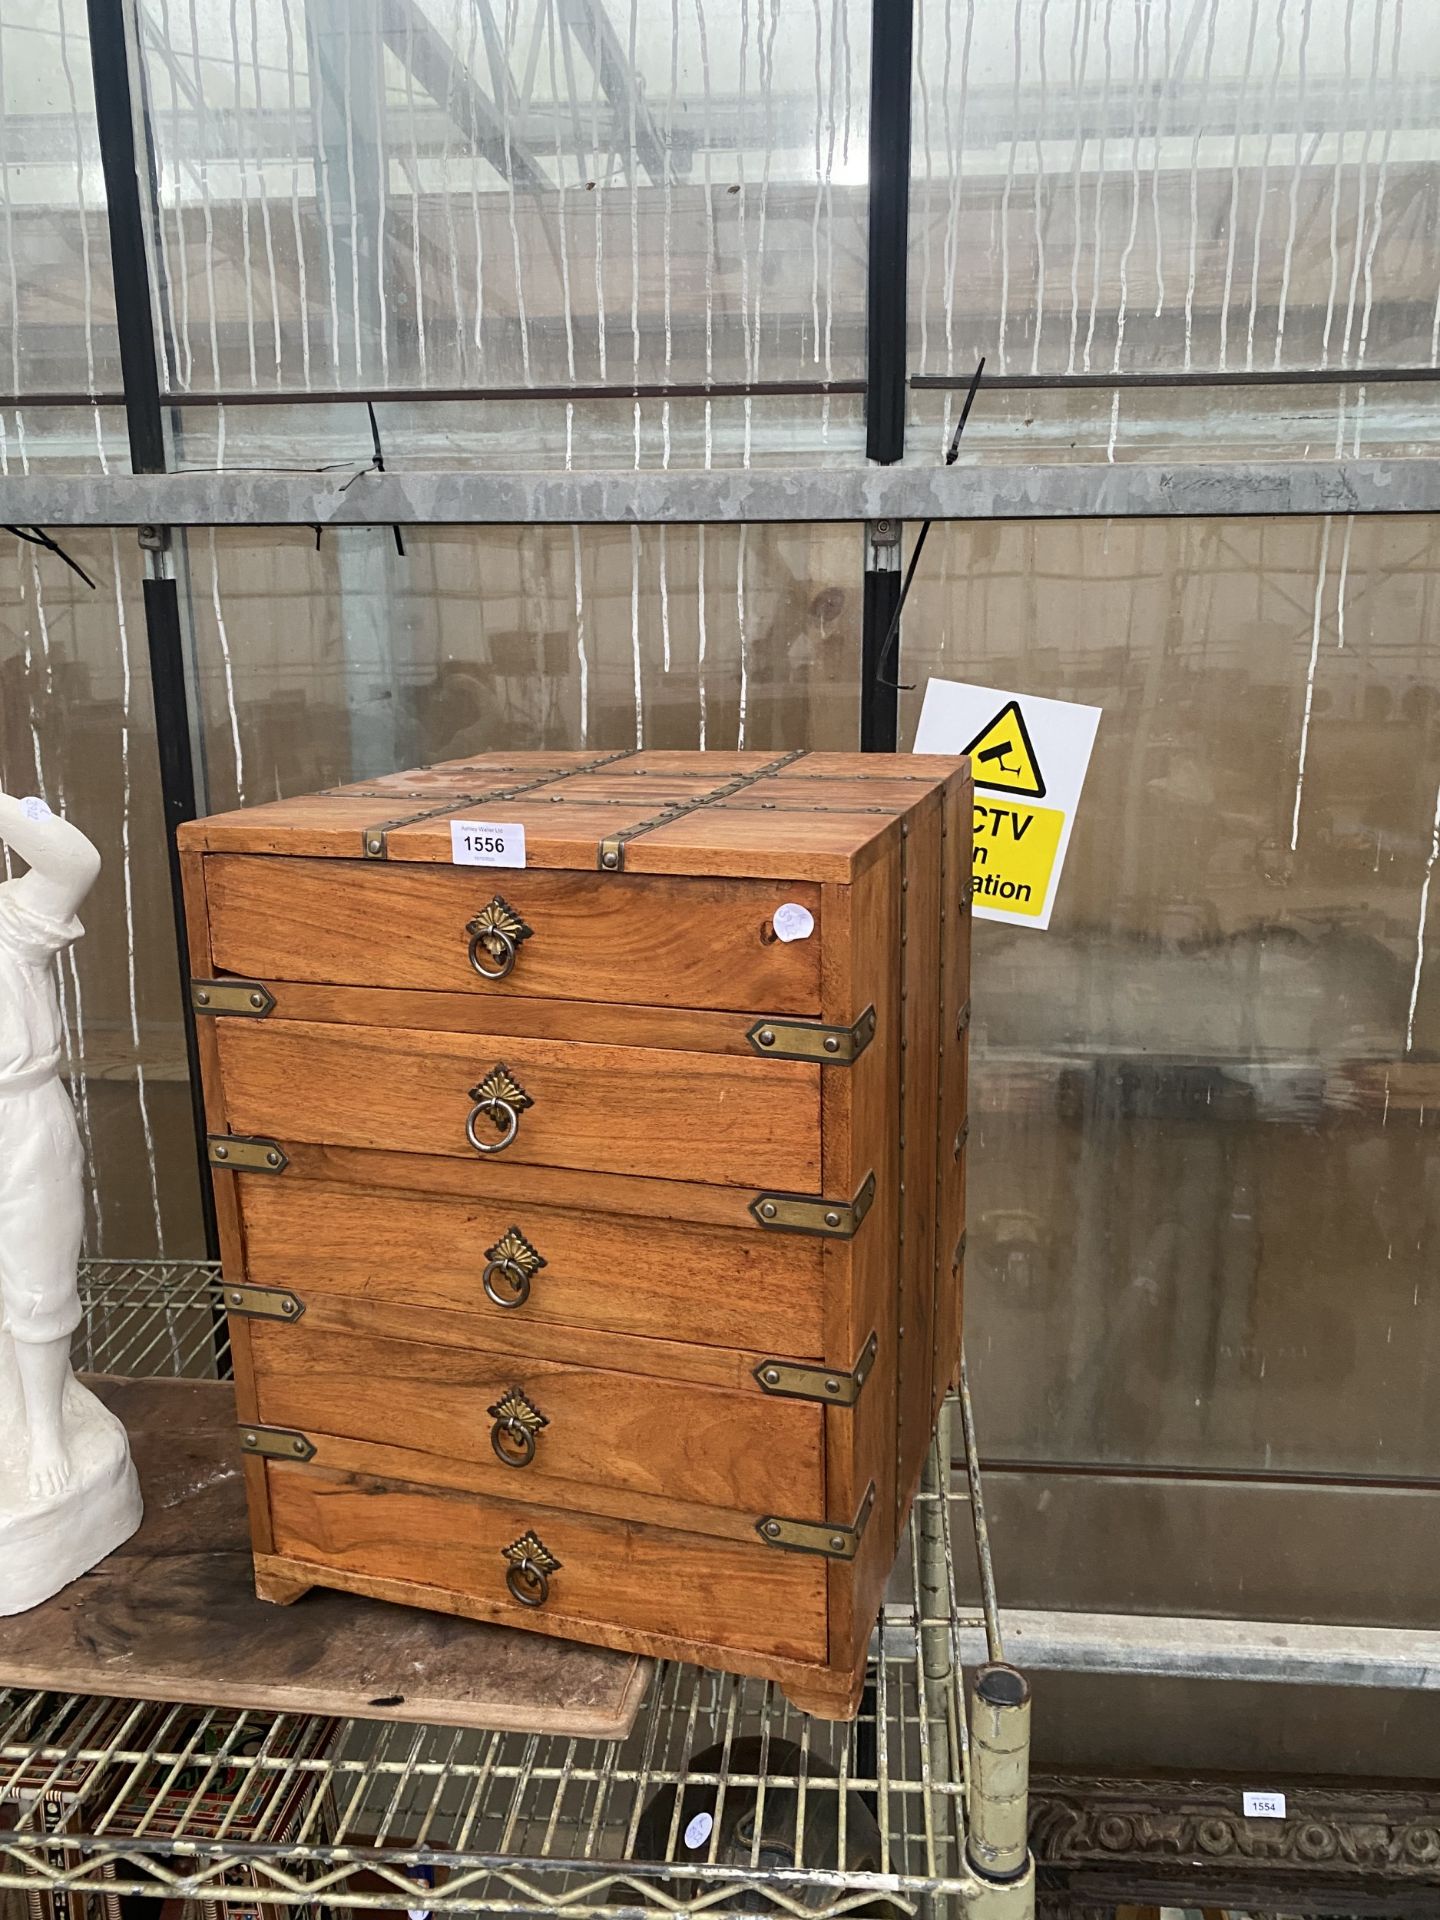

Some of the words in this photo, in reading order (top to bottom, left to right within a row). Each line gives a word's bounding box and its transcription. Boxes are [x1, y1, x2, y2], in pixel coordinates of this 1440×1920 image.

[973, 805, 1034, 841] CTV
[463, 836, 505, 853] 1556
[972, 846, 988, 864] n
[972, 874, 1032, 902] ation
[1252, 1802, 1276, 1811] 1554
